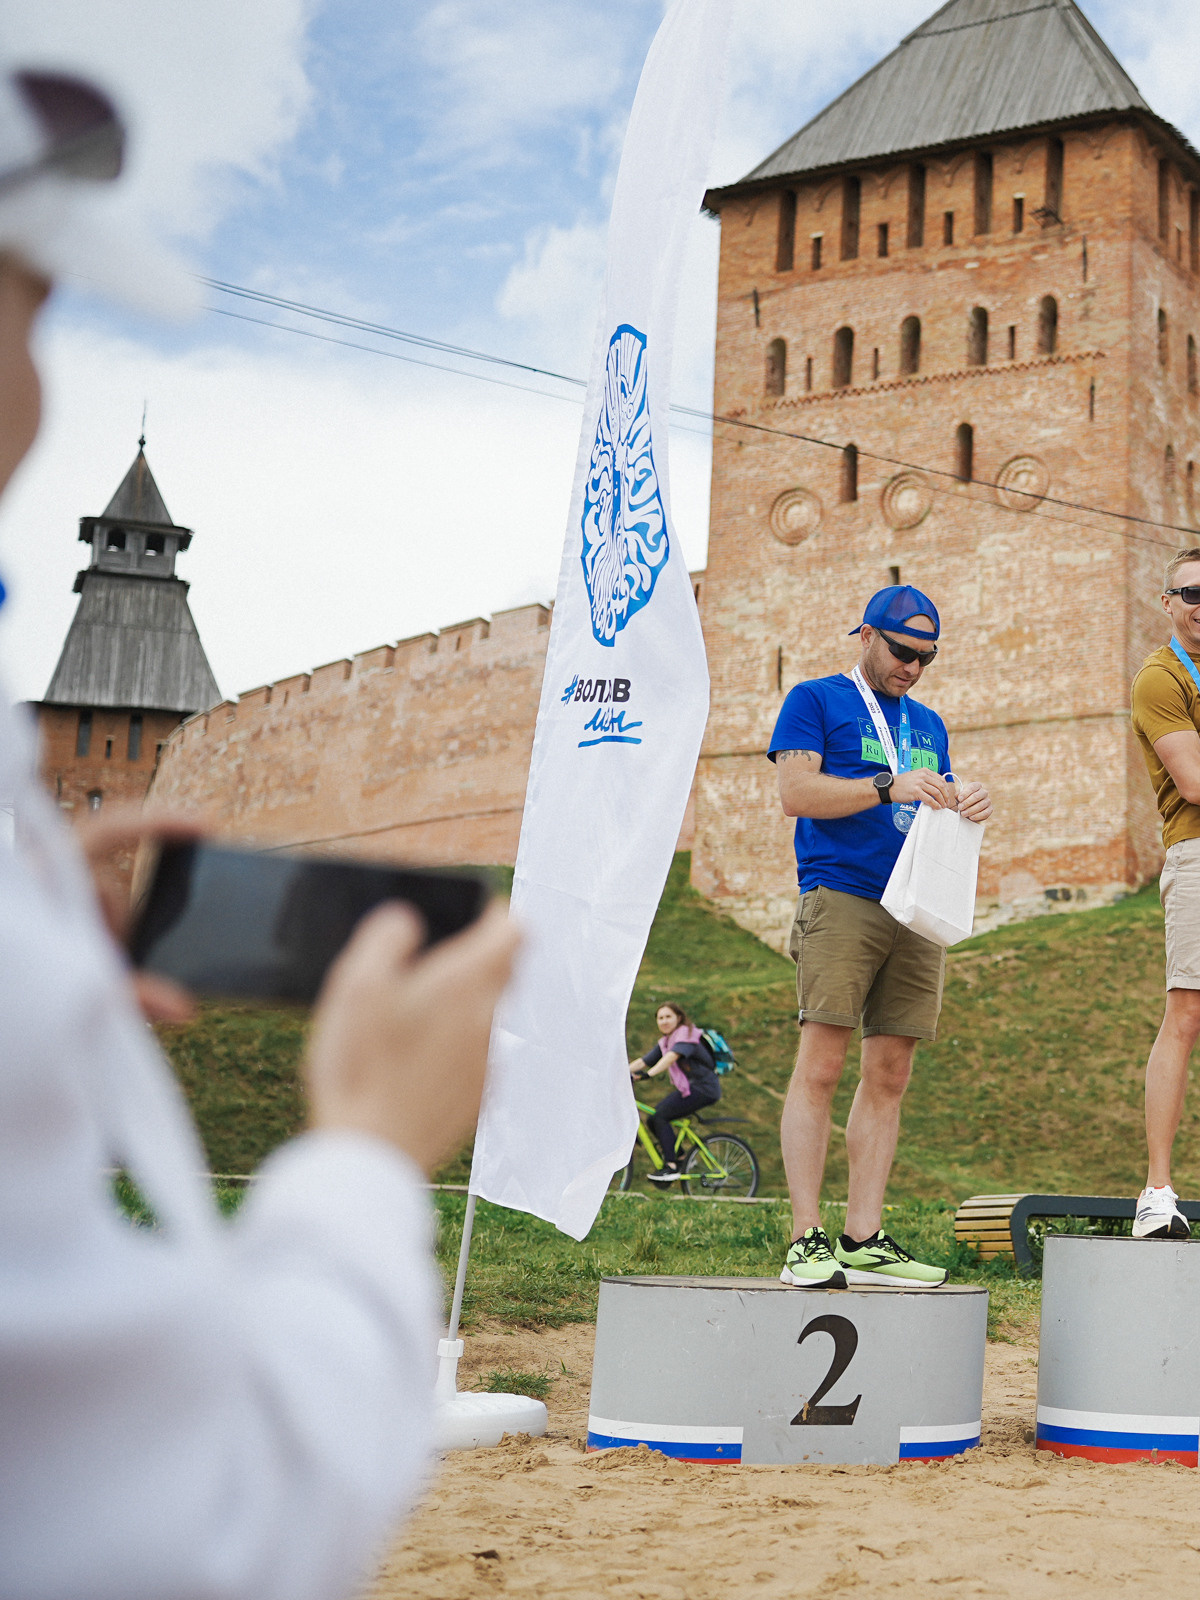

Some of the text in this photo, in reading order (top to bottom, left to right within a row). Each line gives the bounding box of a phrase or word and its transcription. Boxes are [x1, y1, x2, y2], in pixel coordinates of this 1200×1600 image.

[866, 724, 932, 746] S M
[790, 1314, 862, 1425] 2
